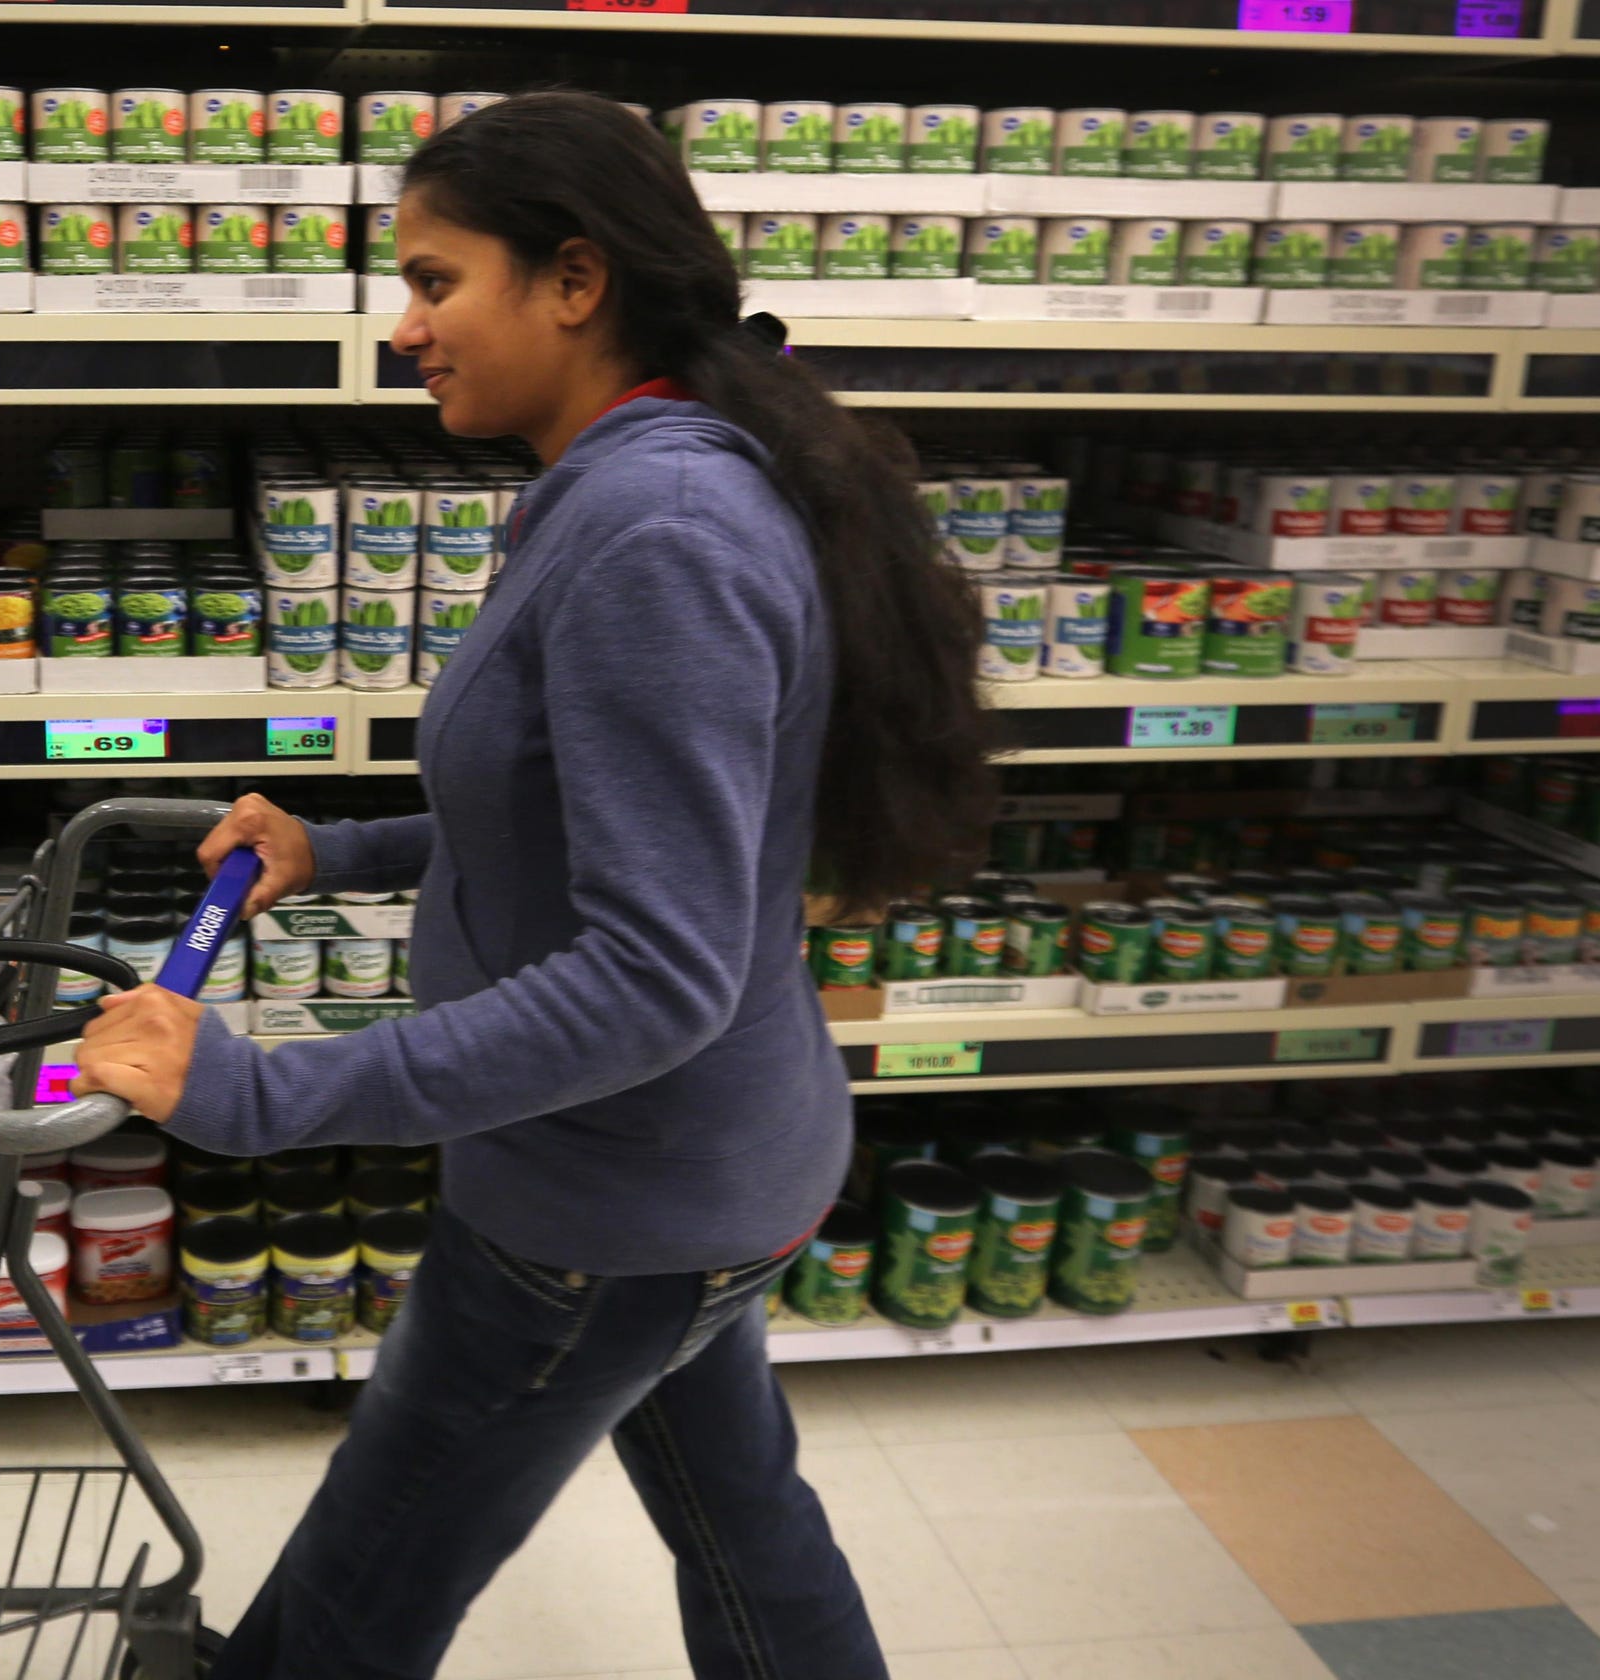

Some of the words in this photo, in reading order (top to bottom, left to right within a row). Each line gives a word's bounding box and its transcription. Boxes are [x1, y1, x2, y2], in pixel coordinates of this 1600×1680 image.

[83, 736, 134, 752] .69
[293, 734, 331, 748] .69
[184, 904, 229, 952] KROGER
